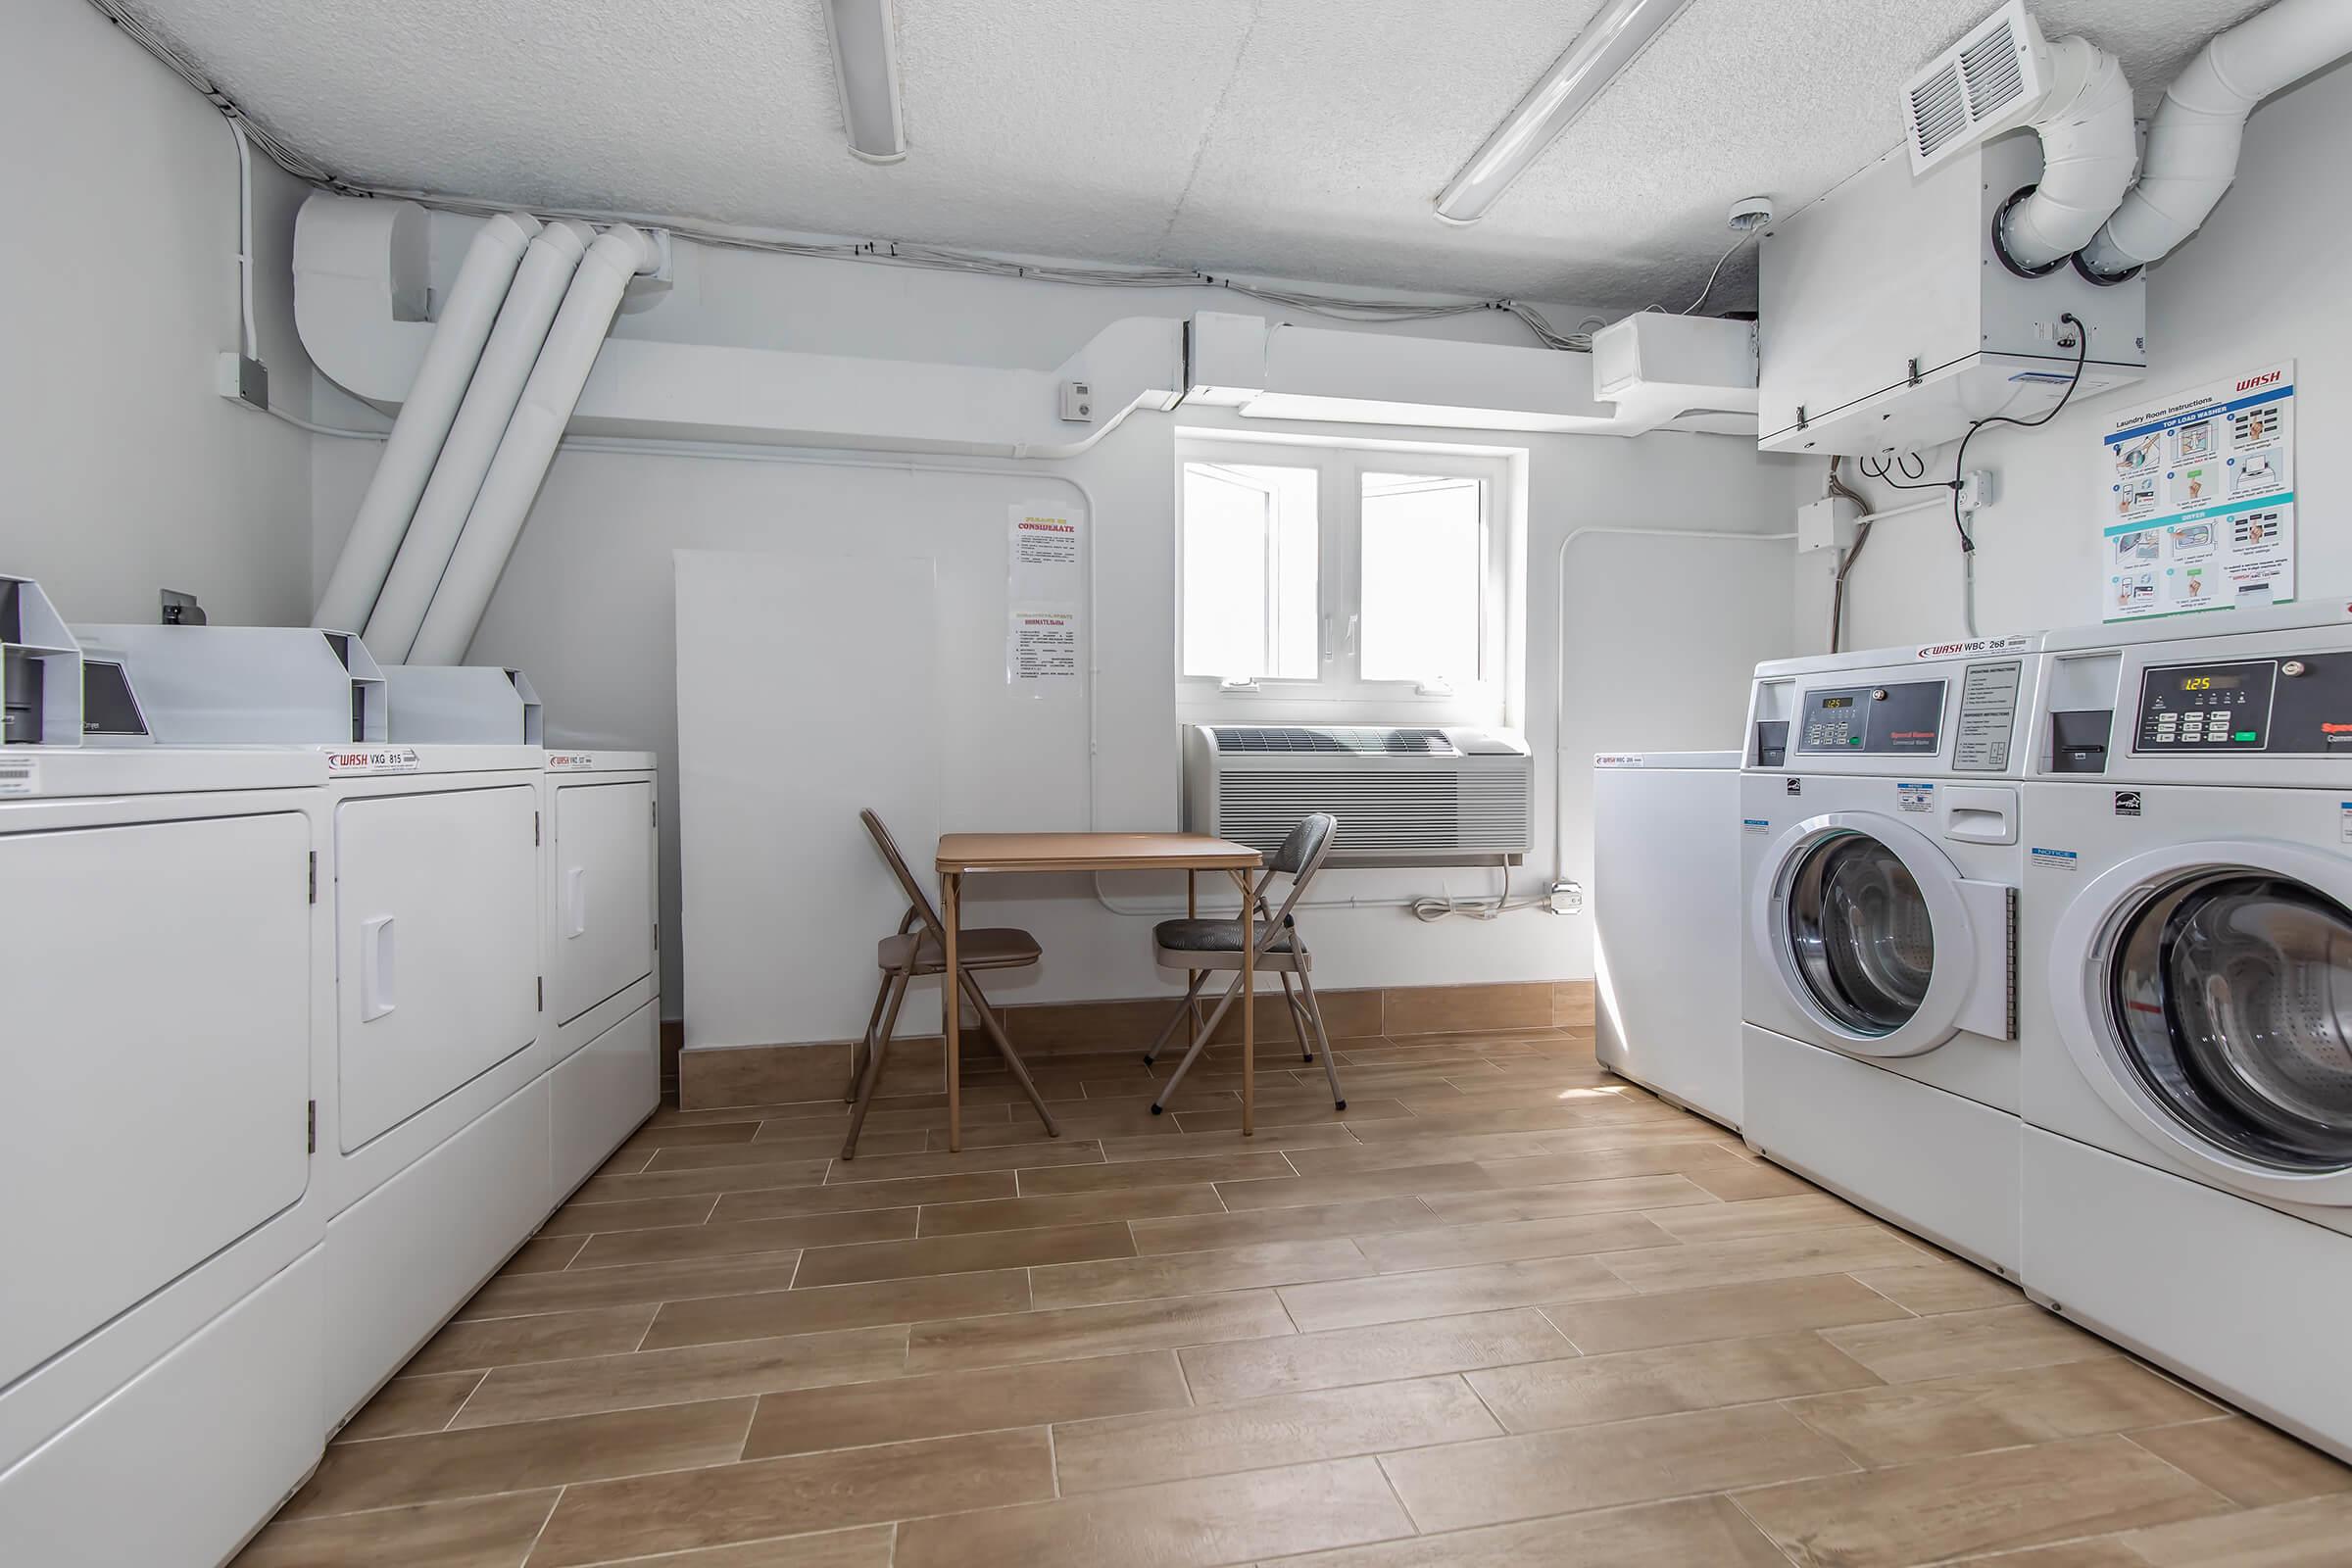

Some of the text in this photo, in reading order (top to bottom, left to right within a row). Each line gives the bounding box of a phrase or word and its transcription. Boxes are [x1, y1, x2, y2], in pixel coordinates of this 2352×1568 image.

[2236, 370, 2281, 392] WASH
[2116, 396, 2213, 428] Laundry Room Instructions
[2163, 406, 2228, 428] TOP LOAD WASHER
[1018, 522, 1075, 533] CONSIDERATE
[1933, 643, 1963, 655] WASH
[1964, 641, 1985, 652] WBC
[1989, 639, 2005, 650] 268
[340, 753, 402, 766] WASH VXG 815
[2037, 848, 2072, 858] NOTICE
